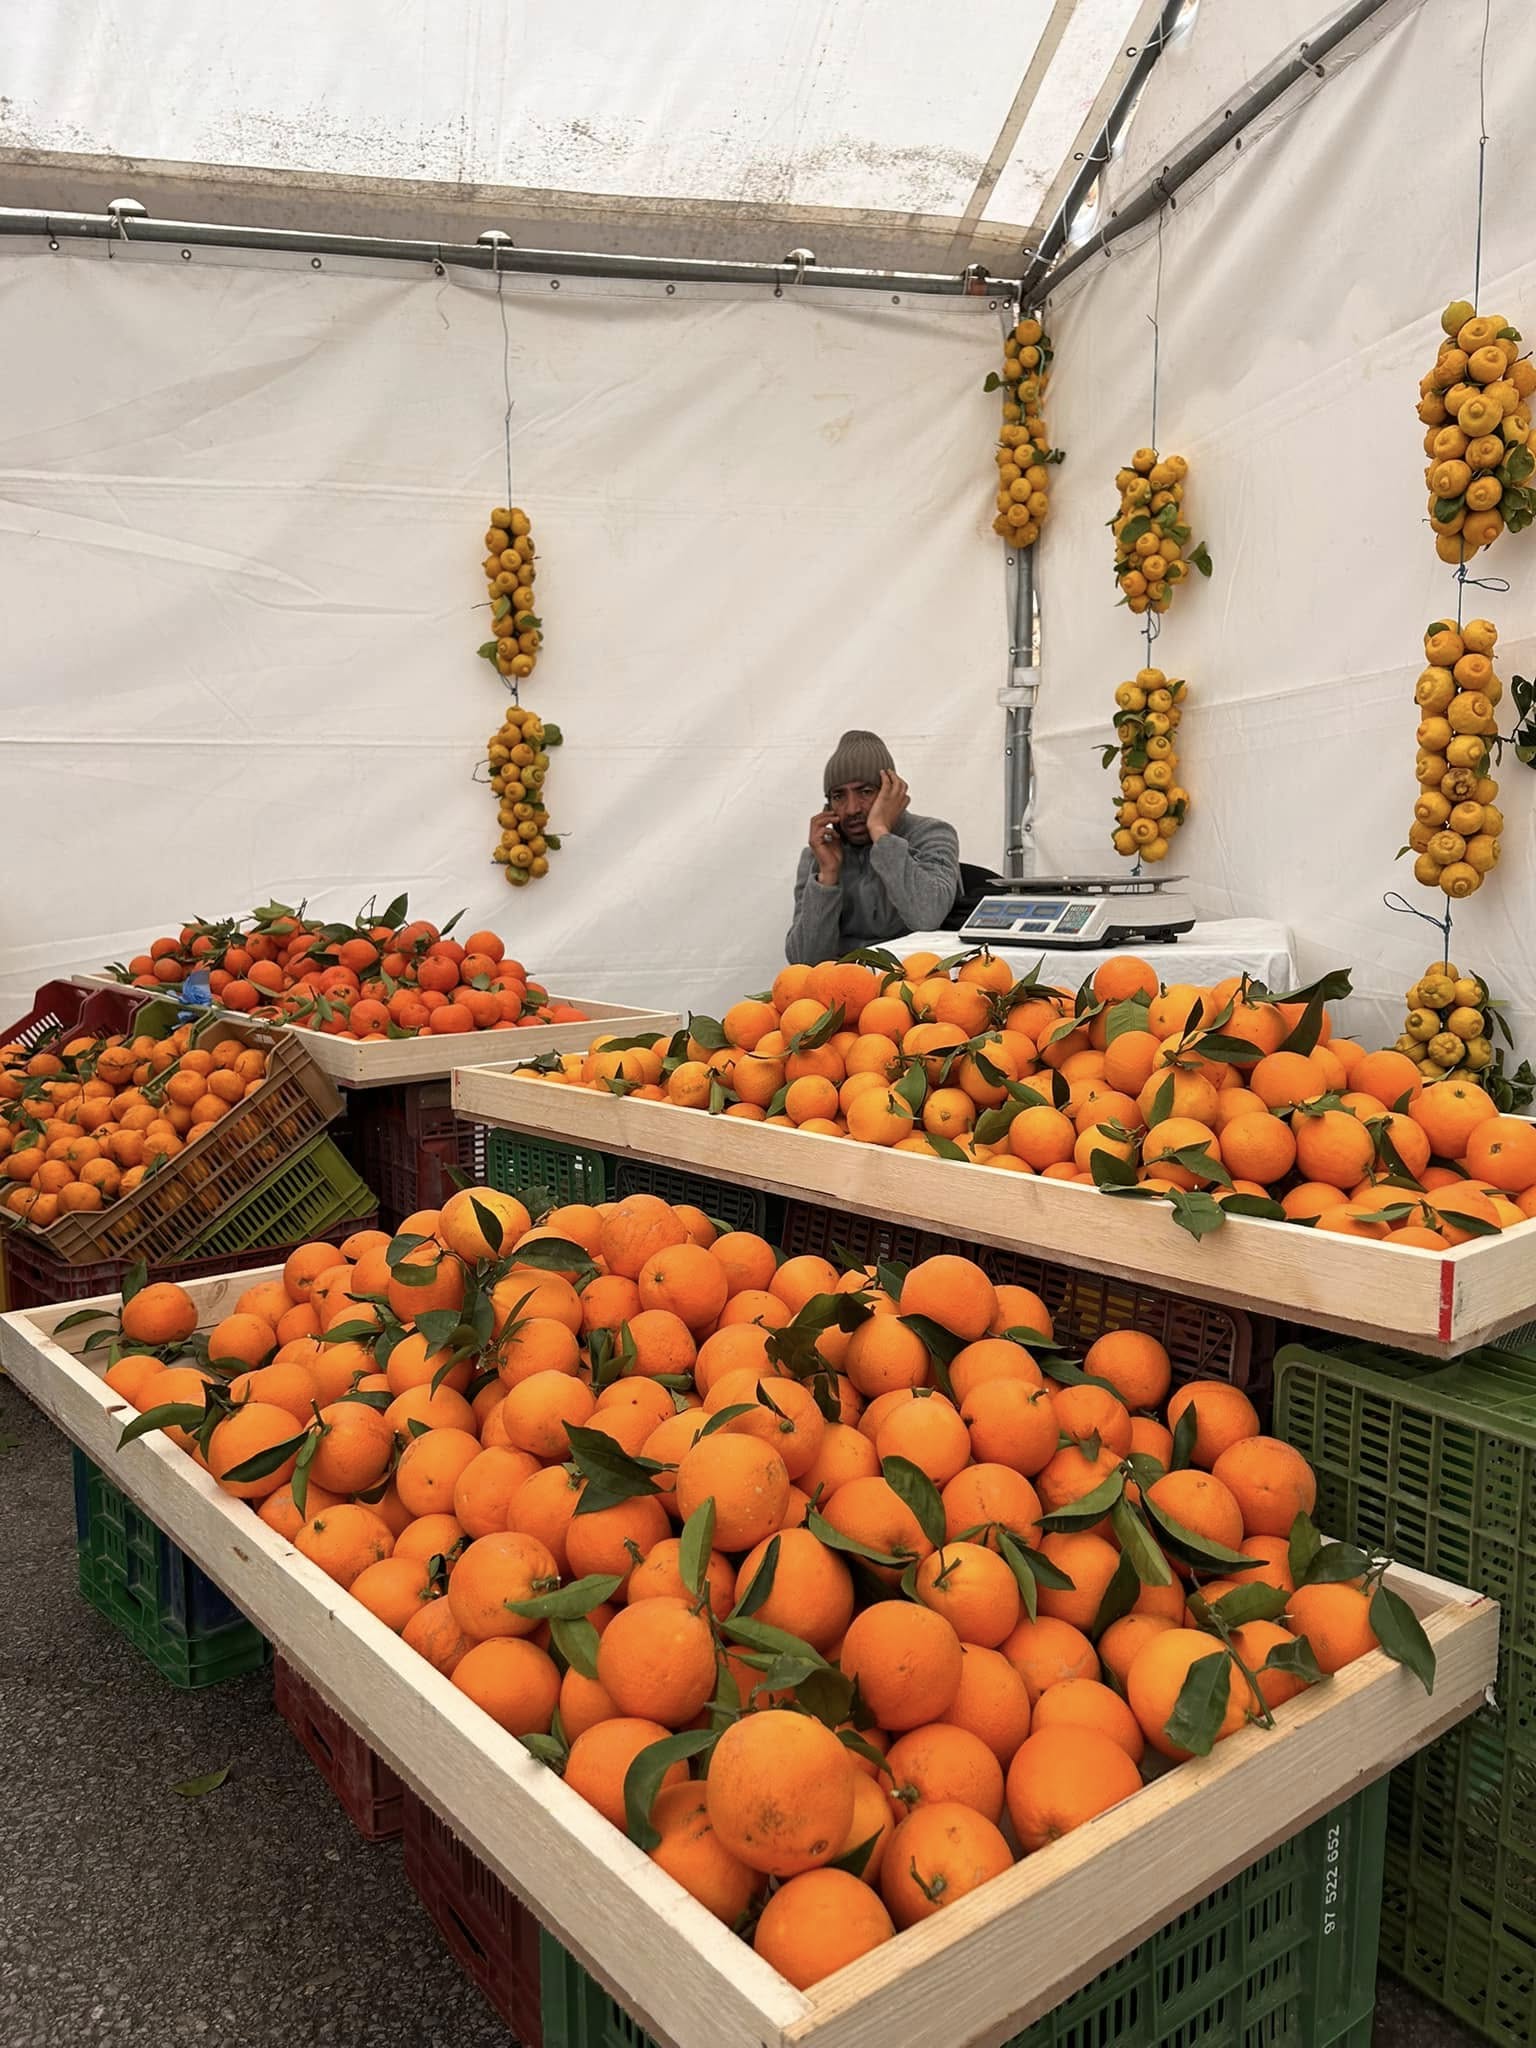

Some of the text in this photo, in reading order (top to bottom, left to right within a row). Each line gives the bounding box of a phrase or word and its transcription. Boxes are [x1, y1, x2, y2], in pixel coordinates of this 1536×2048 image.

[1324, 1824, 1340, 1935] 97 522 652
